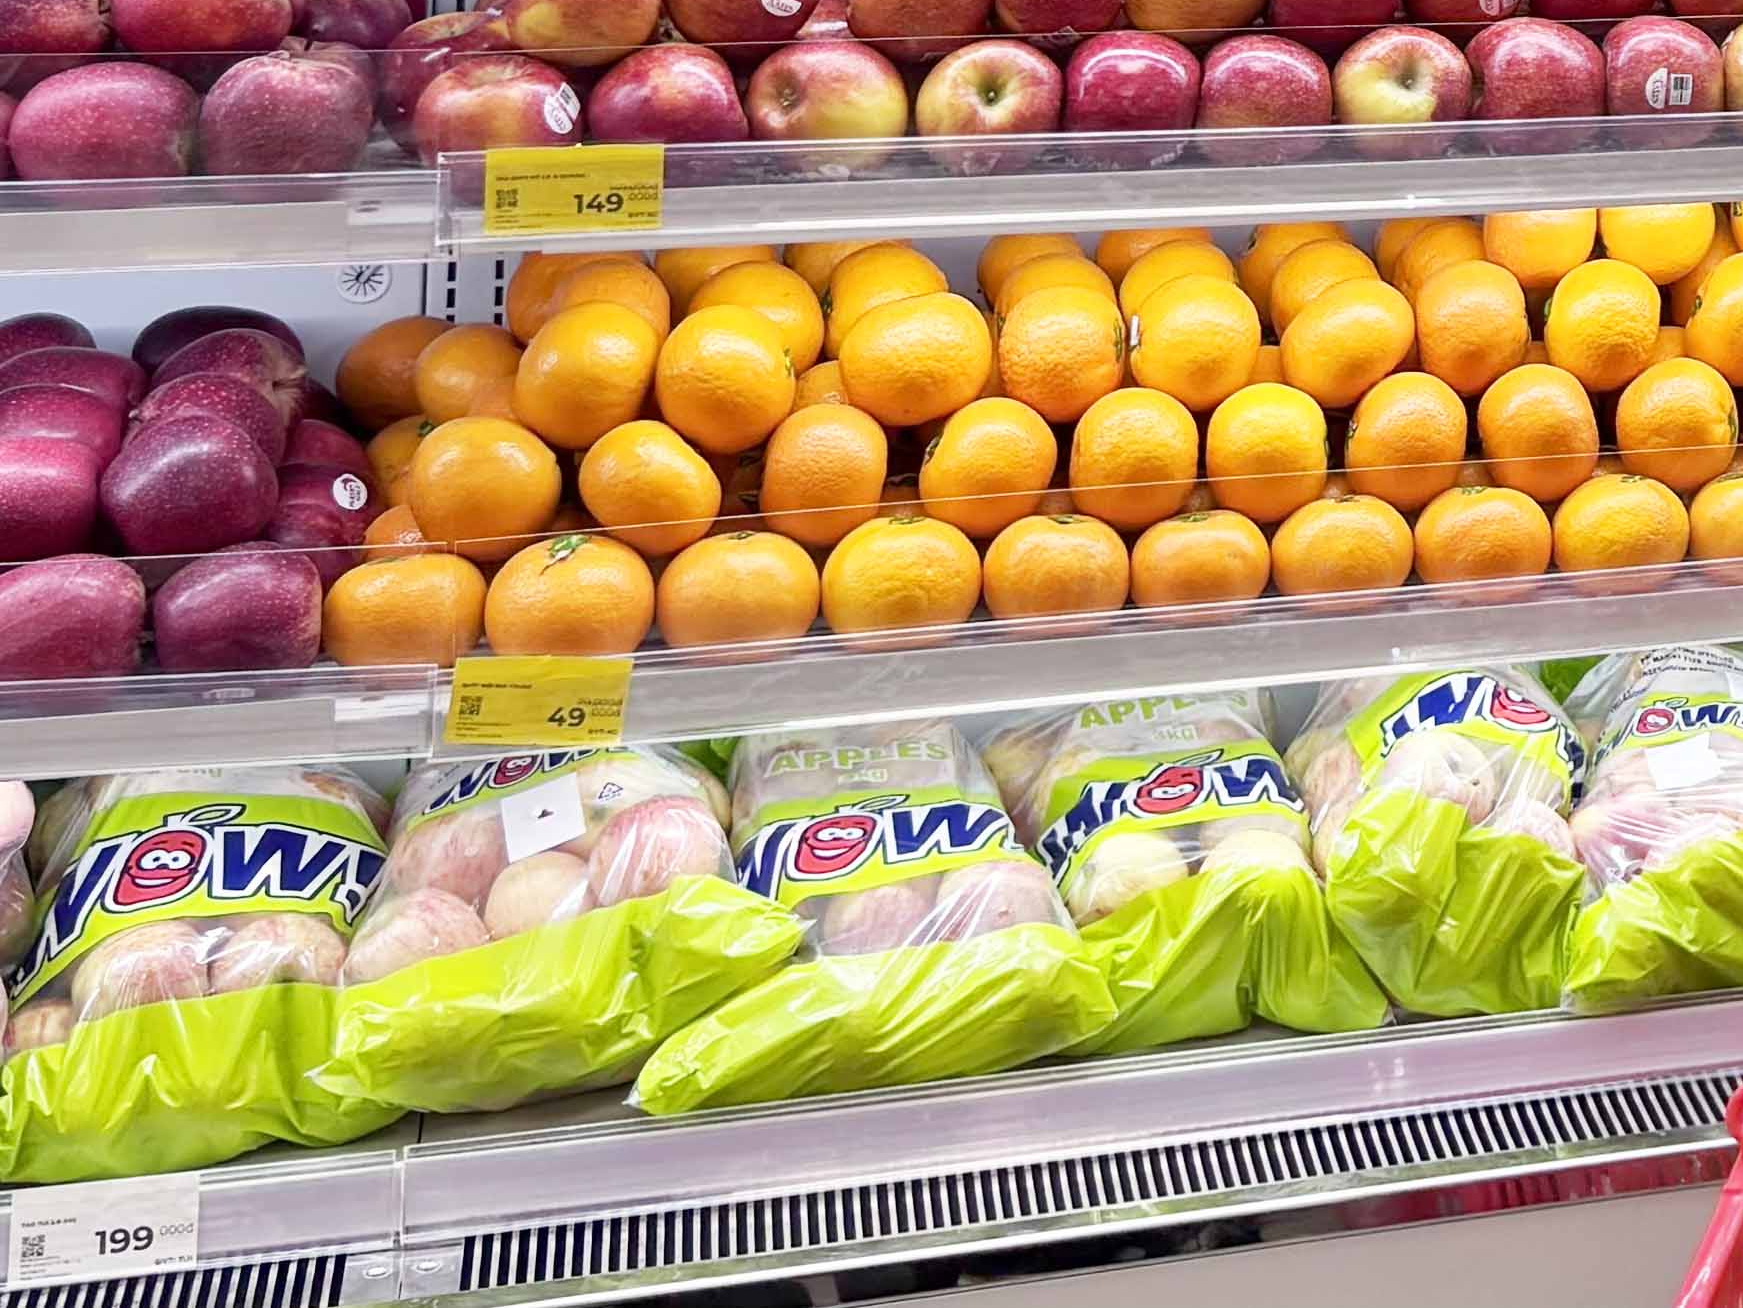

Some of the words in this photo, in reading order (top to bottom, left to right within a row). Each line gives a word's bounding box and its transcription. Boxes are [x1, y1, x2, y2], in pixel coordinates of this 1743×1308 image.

[574, 193, 624, 214] 149
[547, 707, 586, 727] 49
[95, 1226, 153, 1255] 199
